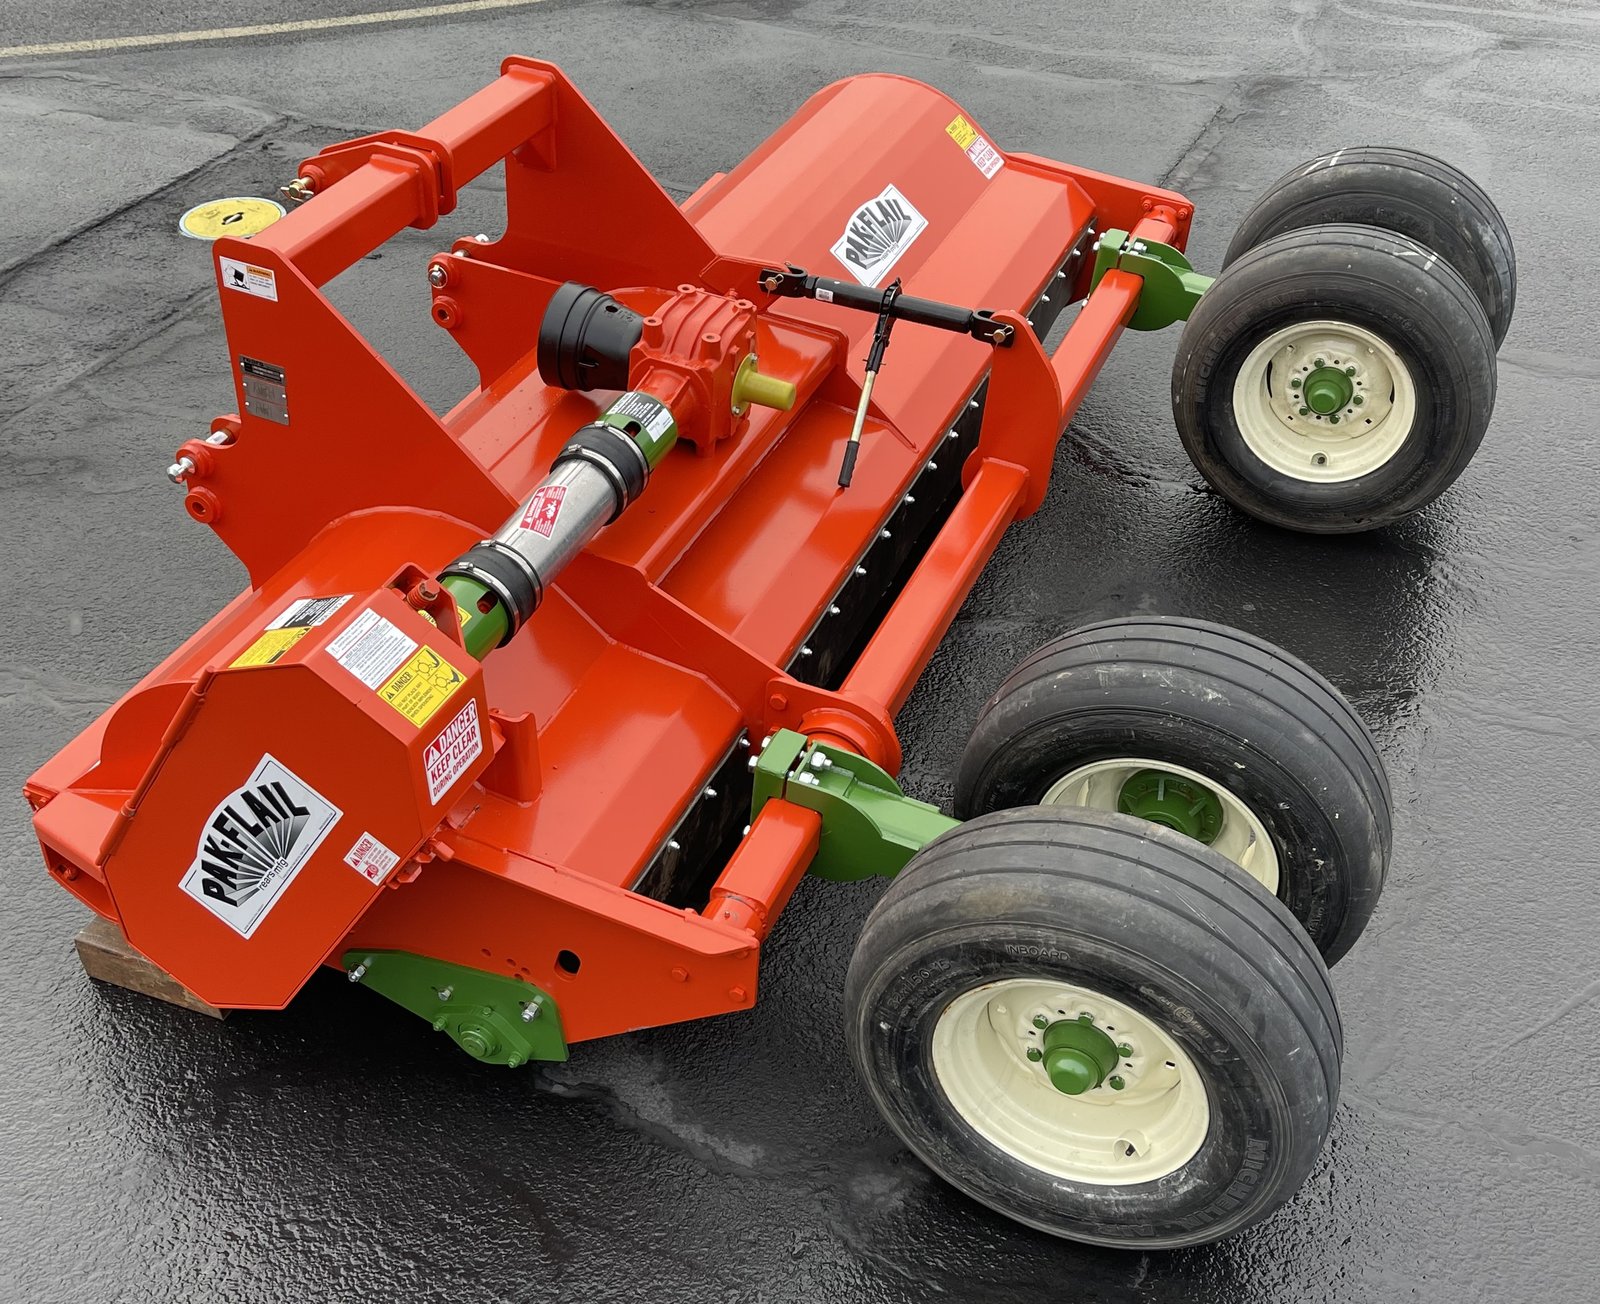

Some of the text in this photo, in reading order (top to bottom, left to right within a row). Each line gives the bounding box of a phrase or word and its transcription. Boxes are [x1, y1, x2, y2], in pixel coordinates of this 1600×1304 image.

[391, 671, 413, 692] DANGER
[438, 702, 476, 749] DANGER
[429, 724, 477, 784] KEEP CLEAR
[432, 741, 479, 797] DURING OPERATION
[352, 837, 373, 860] DANGER
[257, 869, 276, 891] rears
[272, 857, 289, 875] mfg
[1005, 944, 1071, 961] INBOARD
[1176, 1137, 1269, 1231] MICHELIN
